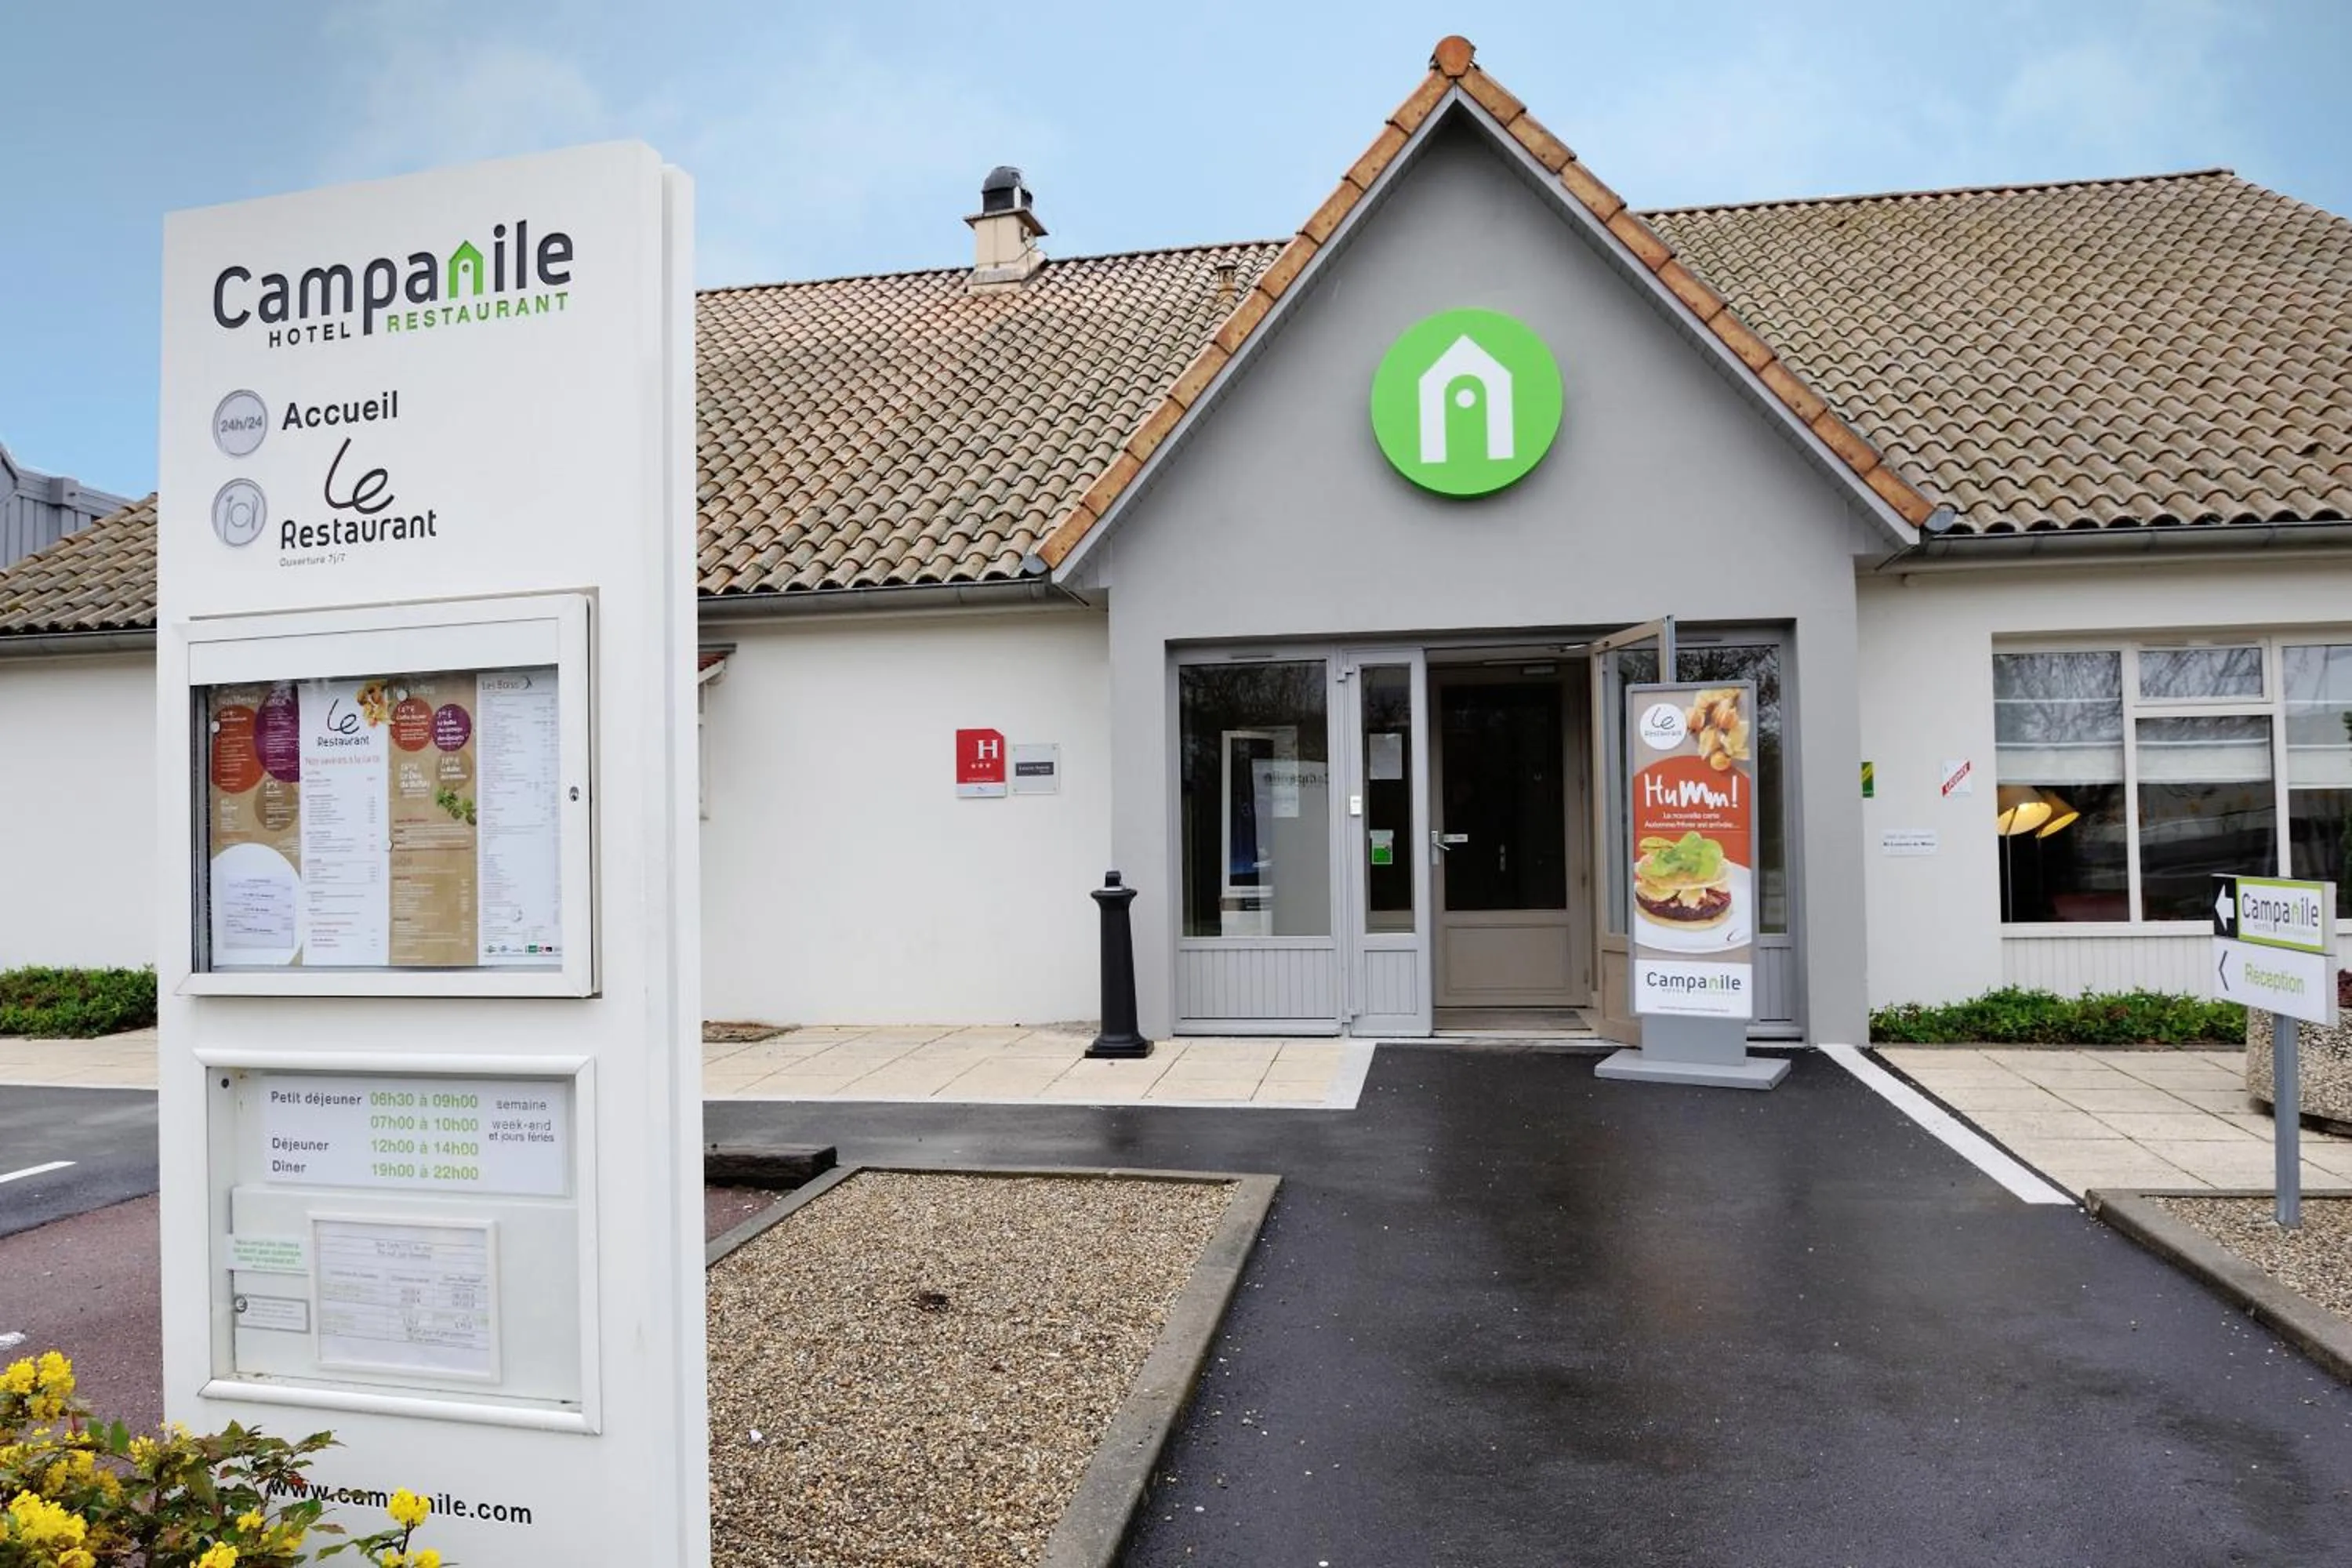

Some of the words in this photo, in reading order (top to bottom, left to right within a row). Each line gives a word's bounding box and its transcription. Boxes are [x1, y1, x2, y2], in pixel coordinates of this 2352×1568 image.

[213, 219, 573, 336] Campanile
[268, 322, 351, 348] HOTEL
[387, 292, 569, 332] RESTAURANT
[282, 390, 398, 430] Accueil
[220, 416, 263, 432] 24h/24
[325, 437, 394, 514] Le
[281, 510, 437, 550] Restaurant
[279, 557, 325, 567] Ouverture
[327, 699, 360, 735] Le
[318, 735, 369, 747] Restaurant
[978, 740, 998, 760] H
[2241, 892, 2320, 932] Campanile
[1646, 971, 1741, 993] Campanile
[270, 1091, 300, 1104] Petit
[305, 1092, 362, 1107] déjeuner
[419, 1094, 427, 1107] à
[433, 1094, 477, 1109] 09h00
[495, 1100, 546, 1110] semaine
[371, 1116, 414, 1130] 07h00
[419, 1116, 427, 1130] à
[434, 1118, 478, 1131] 10h00
[492, 1120, 551, 1131] week-end
[272, 1138, 329, 1152] Déjeuner
[372, 1139, 414, 1153] 12h00
[419, 1141, 427, 1154] à
[434, 1141, 478, 1156] 14h00
[488, 1132, 498, 1141] et
[501, 1132, 524, 1142] jours
[372, 1163, 415, 1178] 19h00
[419, 1164, 428, 1178] à
[434, 1165, 478, 1180] 22h00
